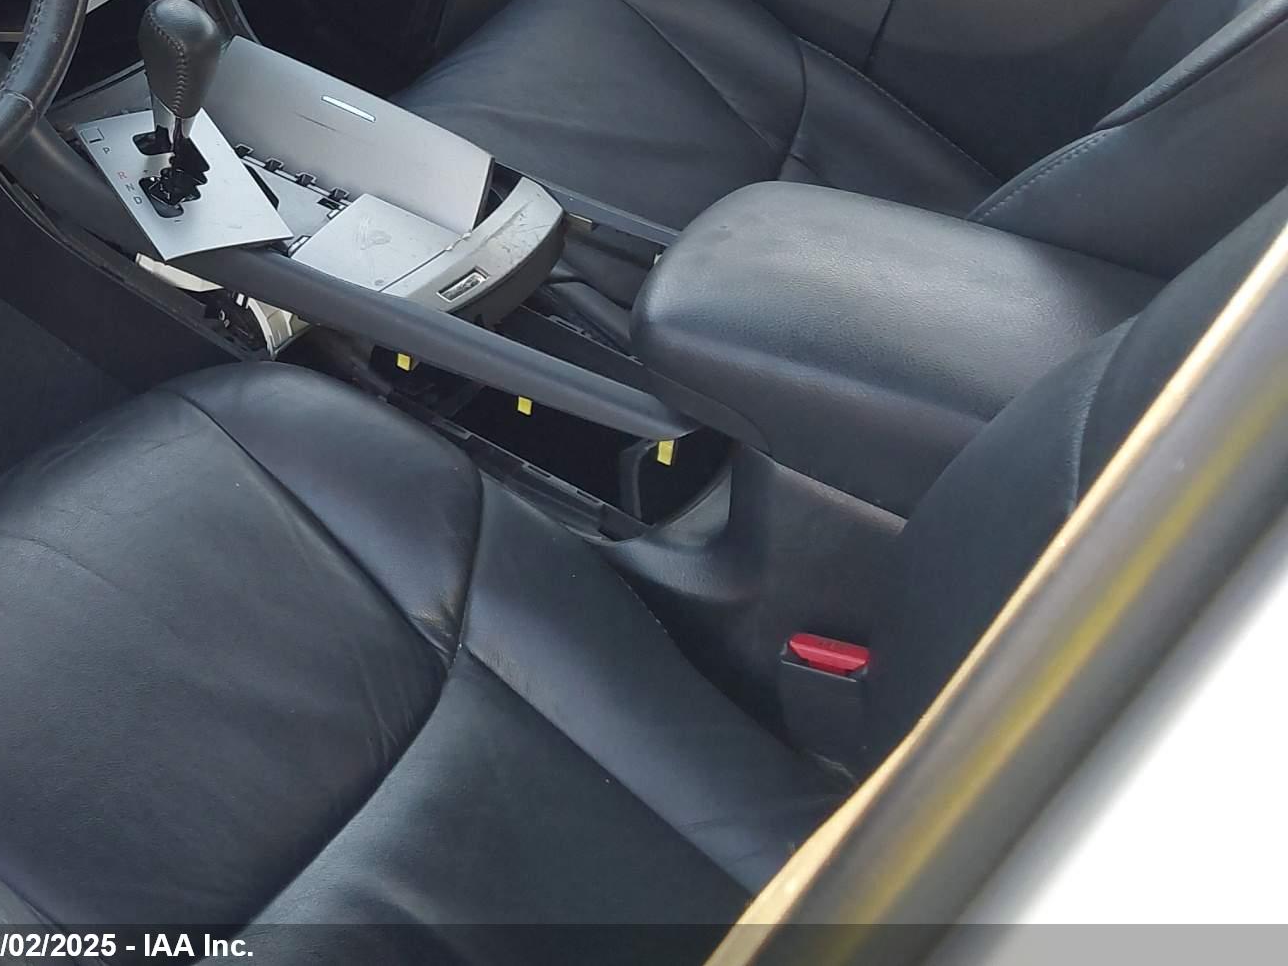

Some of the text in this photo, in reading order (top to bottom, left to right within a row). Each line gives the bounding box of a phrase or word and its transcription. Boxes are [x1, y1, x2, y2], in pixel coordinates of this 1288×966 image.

[103, 146, 110, 154] P
[118, 171, 127, 180] R
[134, 196, 143, 205] D
